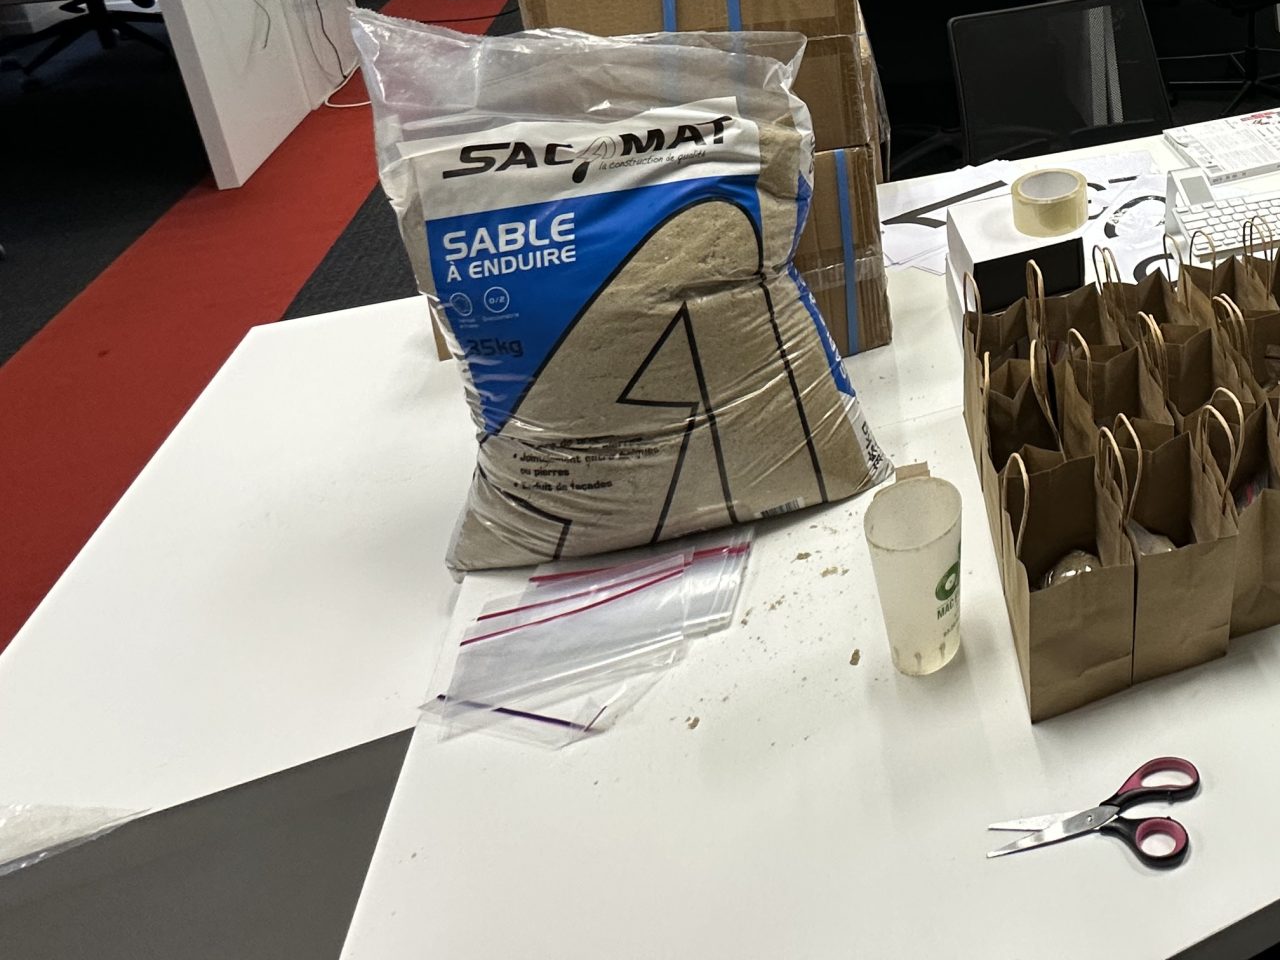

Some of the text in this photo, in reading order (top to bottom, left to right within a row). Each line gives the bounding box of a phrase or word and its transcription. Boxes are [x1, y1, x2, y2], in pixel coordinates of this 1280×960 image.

[609, 155, 663, 169] construction
[666, 152, 674, 161] de
[442, 212, 576, 262] SABLE
[446, 245, 577, 283] À ENDUIRE
[533, 466, 570, 477] pierres
